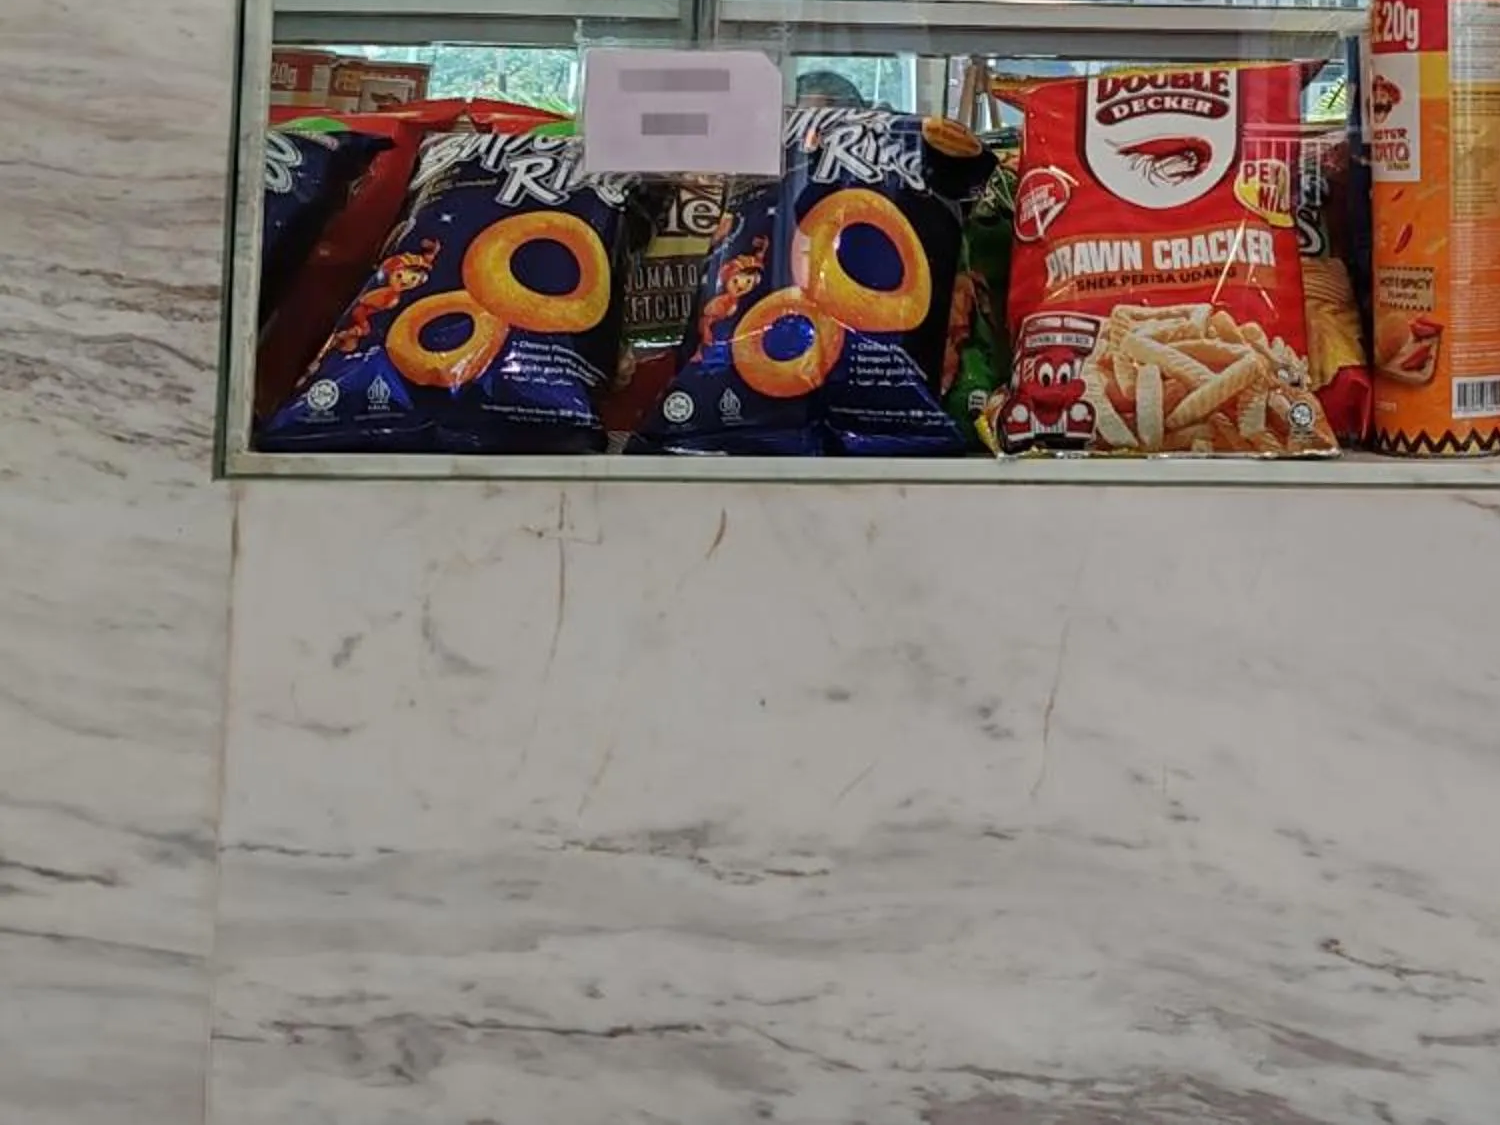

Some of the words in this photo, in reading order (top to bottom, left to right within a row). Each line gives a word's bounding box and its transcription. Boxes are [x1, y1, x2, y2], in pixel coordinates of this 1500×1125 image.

[1097, 69, 1230, 103] DOUBLE
[1110, 96, 1213, 119] DECKER
[1046, 239, 1143, 288] PRAWN
[1152, 227, 1276, 270] CRACKER
